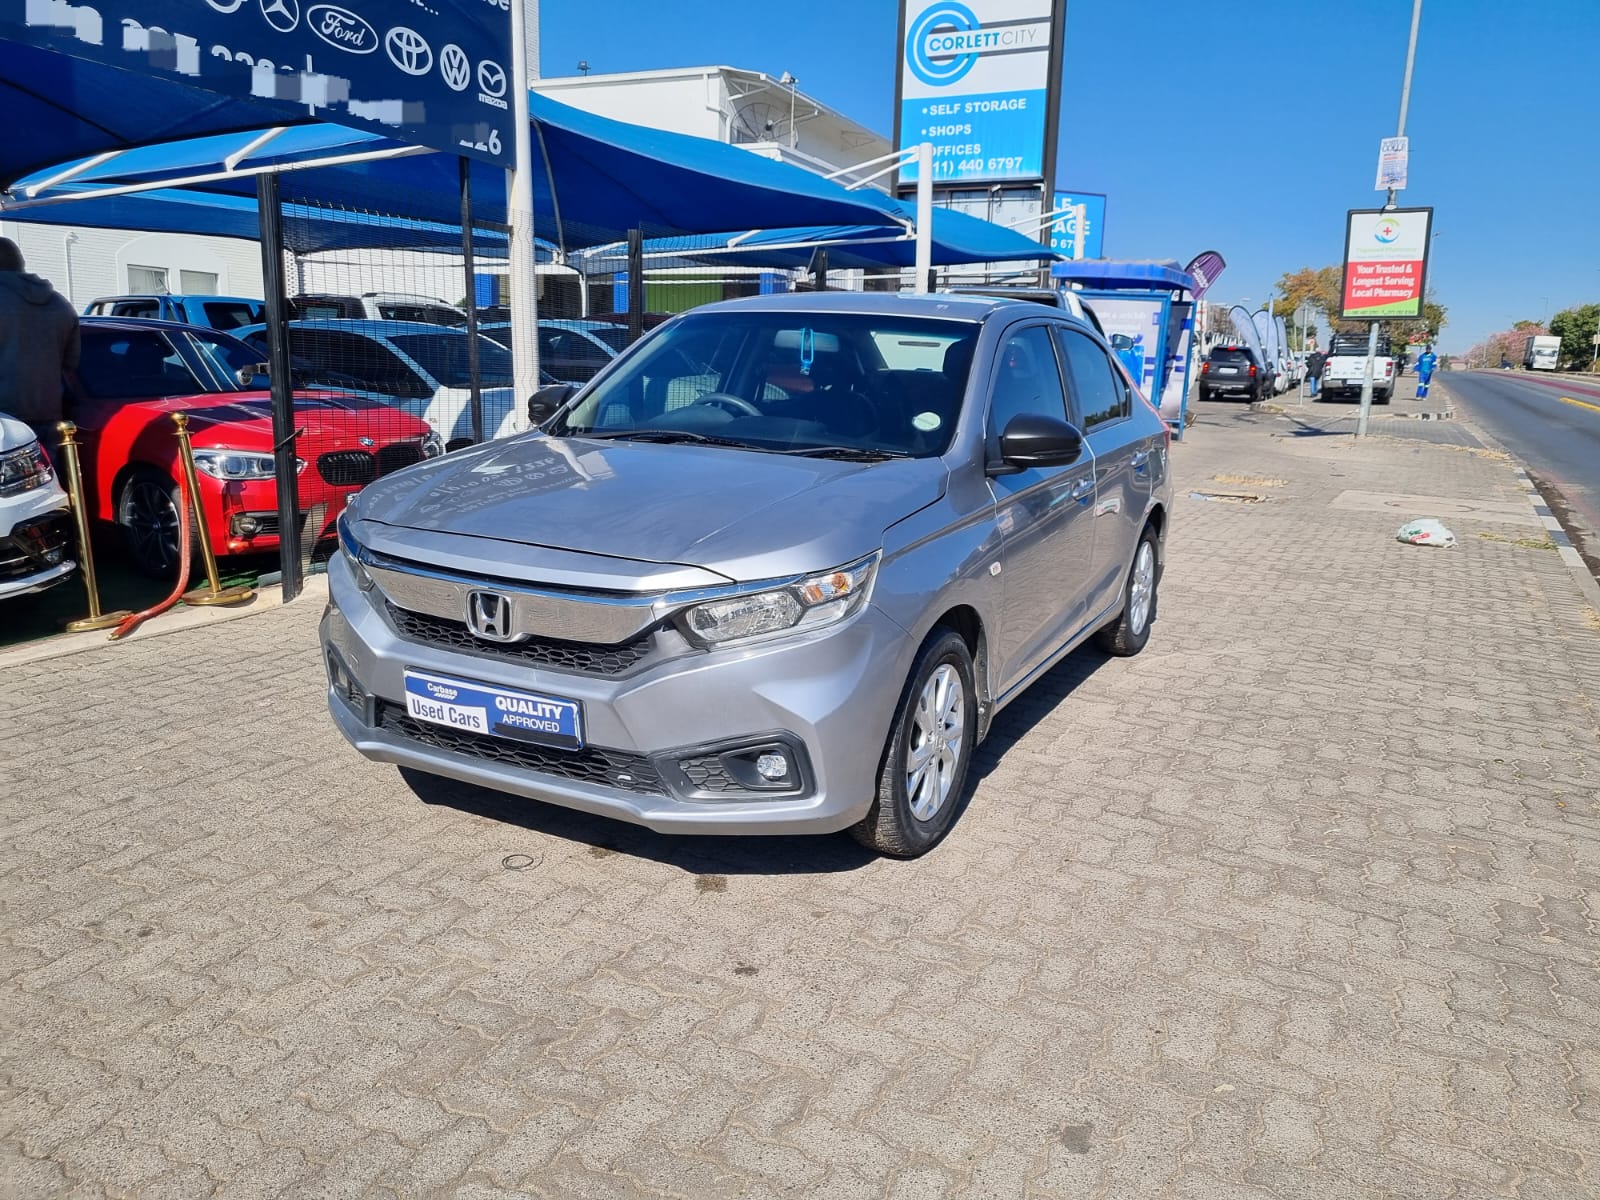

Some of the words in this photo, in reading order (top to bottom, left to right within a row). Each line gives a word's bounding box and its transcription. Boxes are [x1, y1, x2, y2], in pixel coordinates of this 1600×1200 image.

[321, 11, 366, 46] Ford
[478, 93, 508, 110] mazda
[929, 102, 961, 115] SELF
[964, 98, 1027, 113] STORAGE
[928, 124, 972, 137] SHOPS
[958, 159, 984, 170] 440
[988, 157, 1024, 171] 6797
[1356, 265, 1374, 274] Your
[1375, 264, 1405, 273] Trusted
[1406, 264, 1413, 273] &
[1352, 277, 1383, 287] Longest
[1384, 276, 1415, 287] Serving
[1352, 288, 1373, 298] Local
[1374, 288, 1413, 299] Pharmacy
[427, 682, 458, 697] Carbase
[412, 699, 445, 721] Used
[448, 707, 481, 729] Cars
[495, 696, 563, 720] QUALITY
[502, 714, 560, 733] APPROVED
